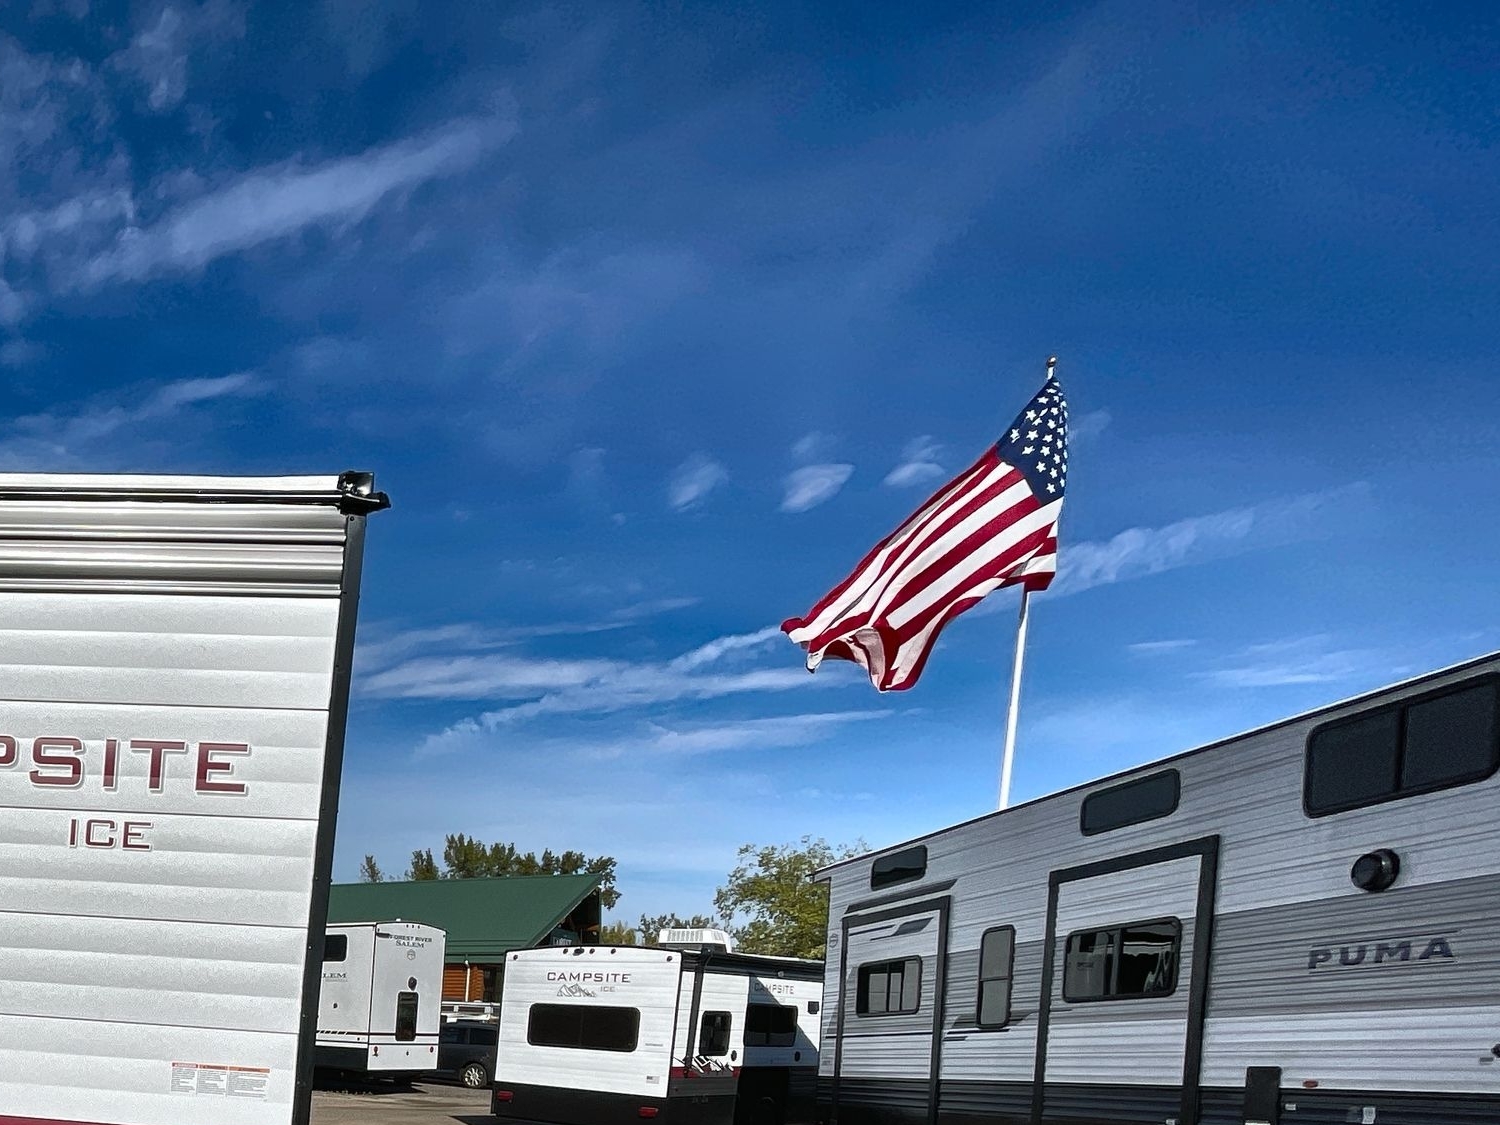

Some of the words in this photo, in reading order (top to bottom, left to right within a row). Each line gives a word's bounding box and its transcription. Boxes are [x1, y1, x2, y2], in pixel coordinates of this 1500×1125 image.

[69, 818, 152, 850] ICE
[396, 940, 425, 948] SALEM
[1308, 937, 1454, 970] PUMA
[547, 971, 631, 983] CAMPSITE
[755, 983, 795, 995] CAMPSITE
